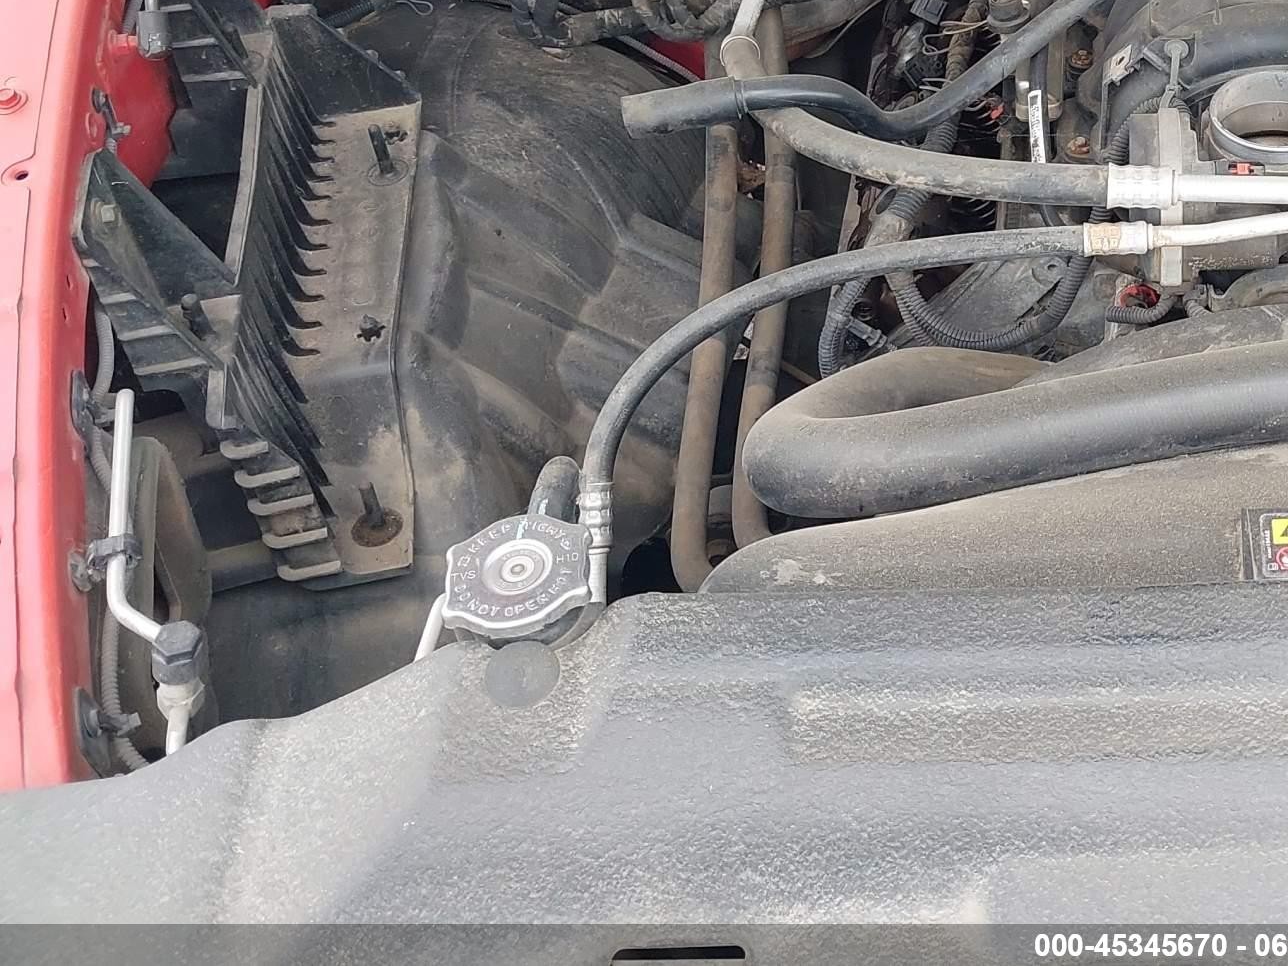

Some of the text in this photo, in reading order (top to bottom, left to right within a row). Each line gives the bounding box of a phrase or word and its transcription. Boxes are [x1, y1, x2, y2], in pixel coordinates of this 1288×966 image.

[468, 523, 513, 554] KEEP
[450, 570, 477, 582] TVS
[467, 597, 500, 617] NOT
[504, 592, 550, 617] OPEN
